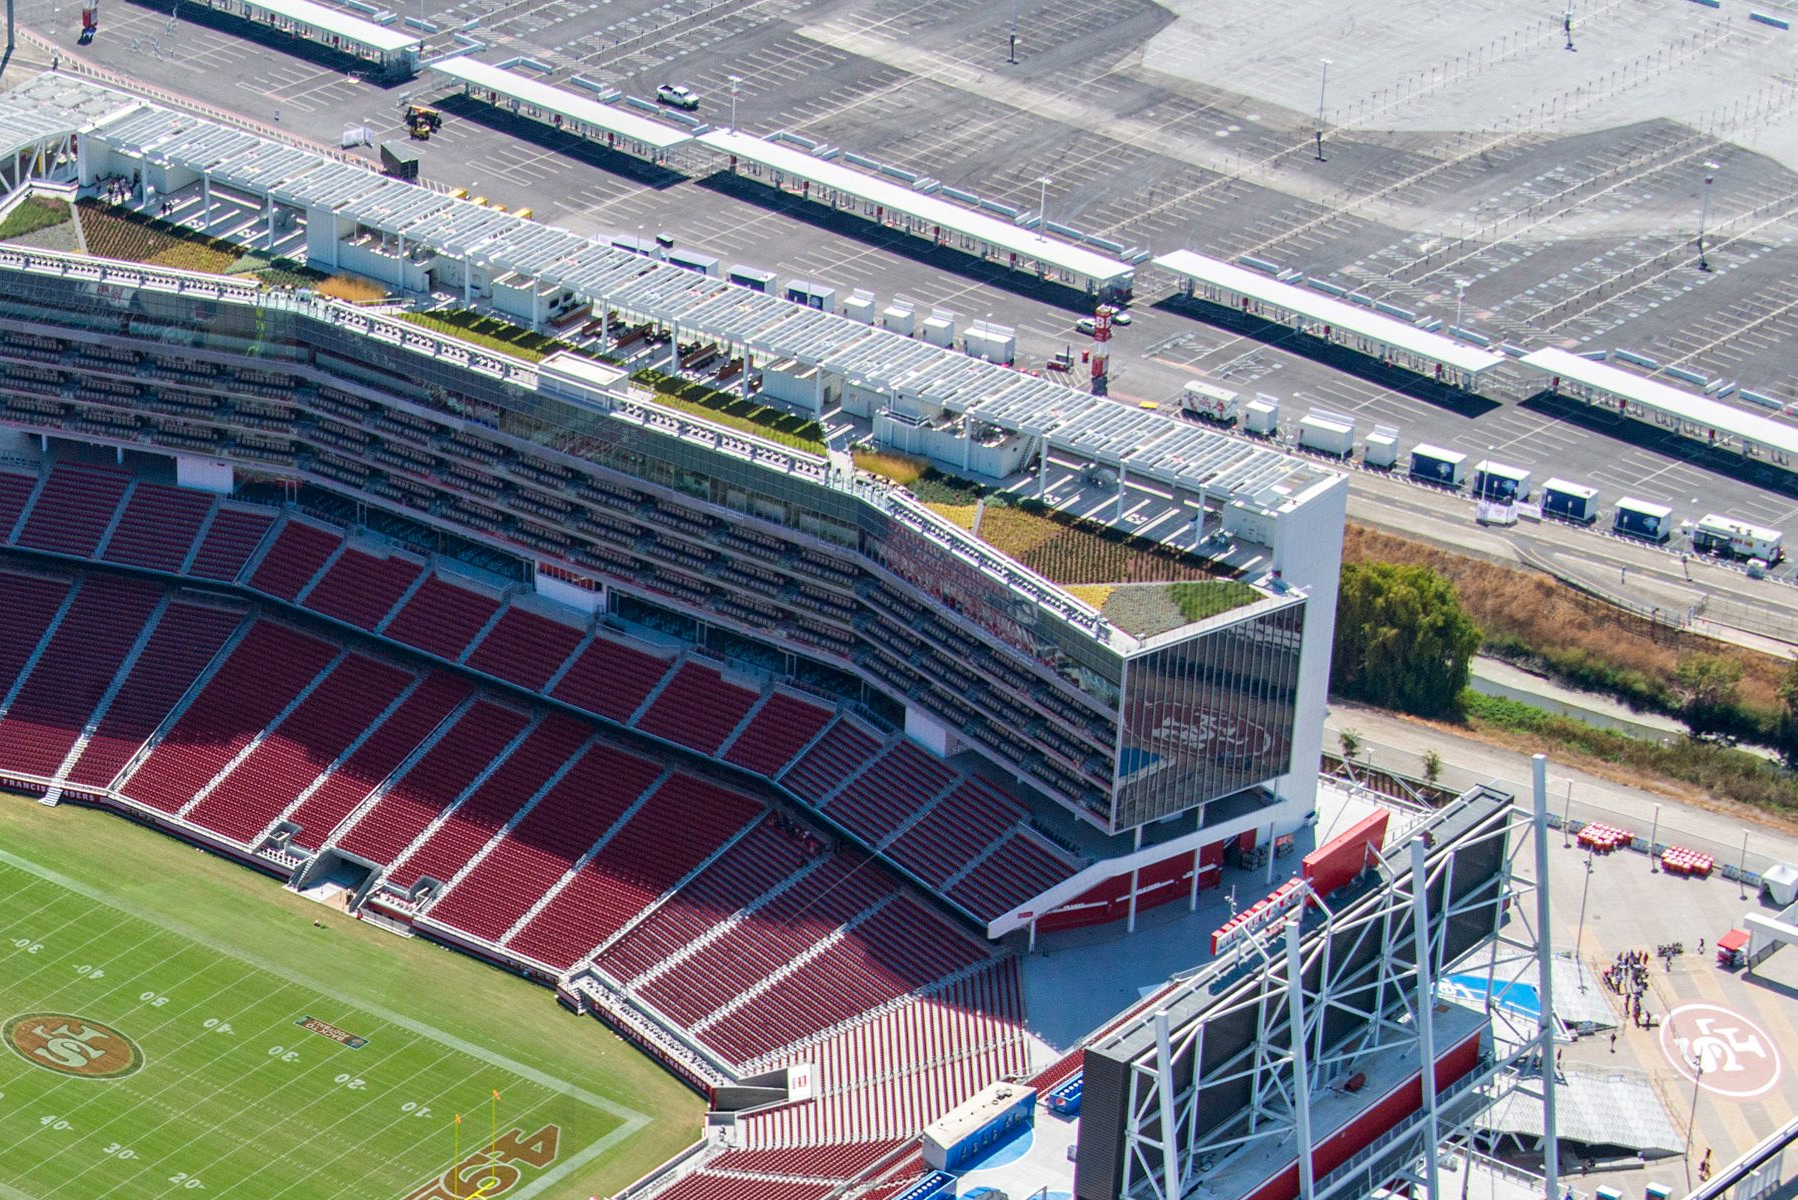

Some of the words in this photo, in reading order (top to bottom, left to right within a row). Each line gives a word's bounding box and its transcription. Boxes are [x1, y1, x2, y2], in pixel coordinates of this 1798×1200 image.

[64, 789, 95, 802] 49ERS
[14, 938, 45, 954] 30
[76, 964, 105, 980] 40
[139, 991, 170, 1008] 50
[203, 1018, 231, 1035] 40
[306, 1023, 319, 1031] TO
[314, 1020, 350, 1038] FOOTBALL
[322, 1029, 345, 1041] BACK
[268, 1045, 299, 1062] 30
[619, 1020, 643, 1042] SUPER
[643, 1040, 663, 1058] BOWL
[664, 1055, 708, 1090] CHAMPIONS
[334, 1073, 365, 1090] 20
[401, 1101, 430, 1118] 10
[40, 1115, 70, 1131] 40
[102, 1142, 135, 1160] 30
[168, 1172, 202, 1190] 20
